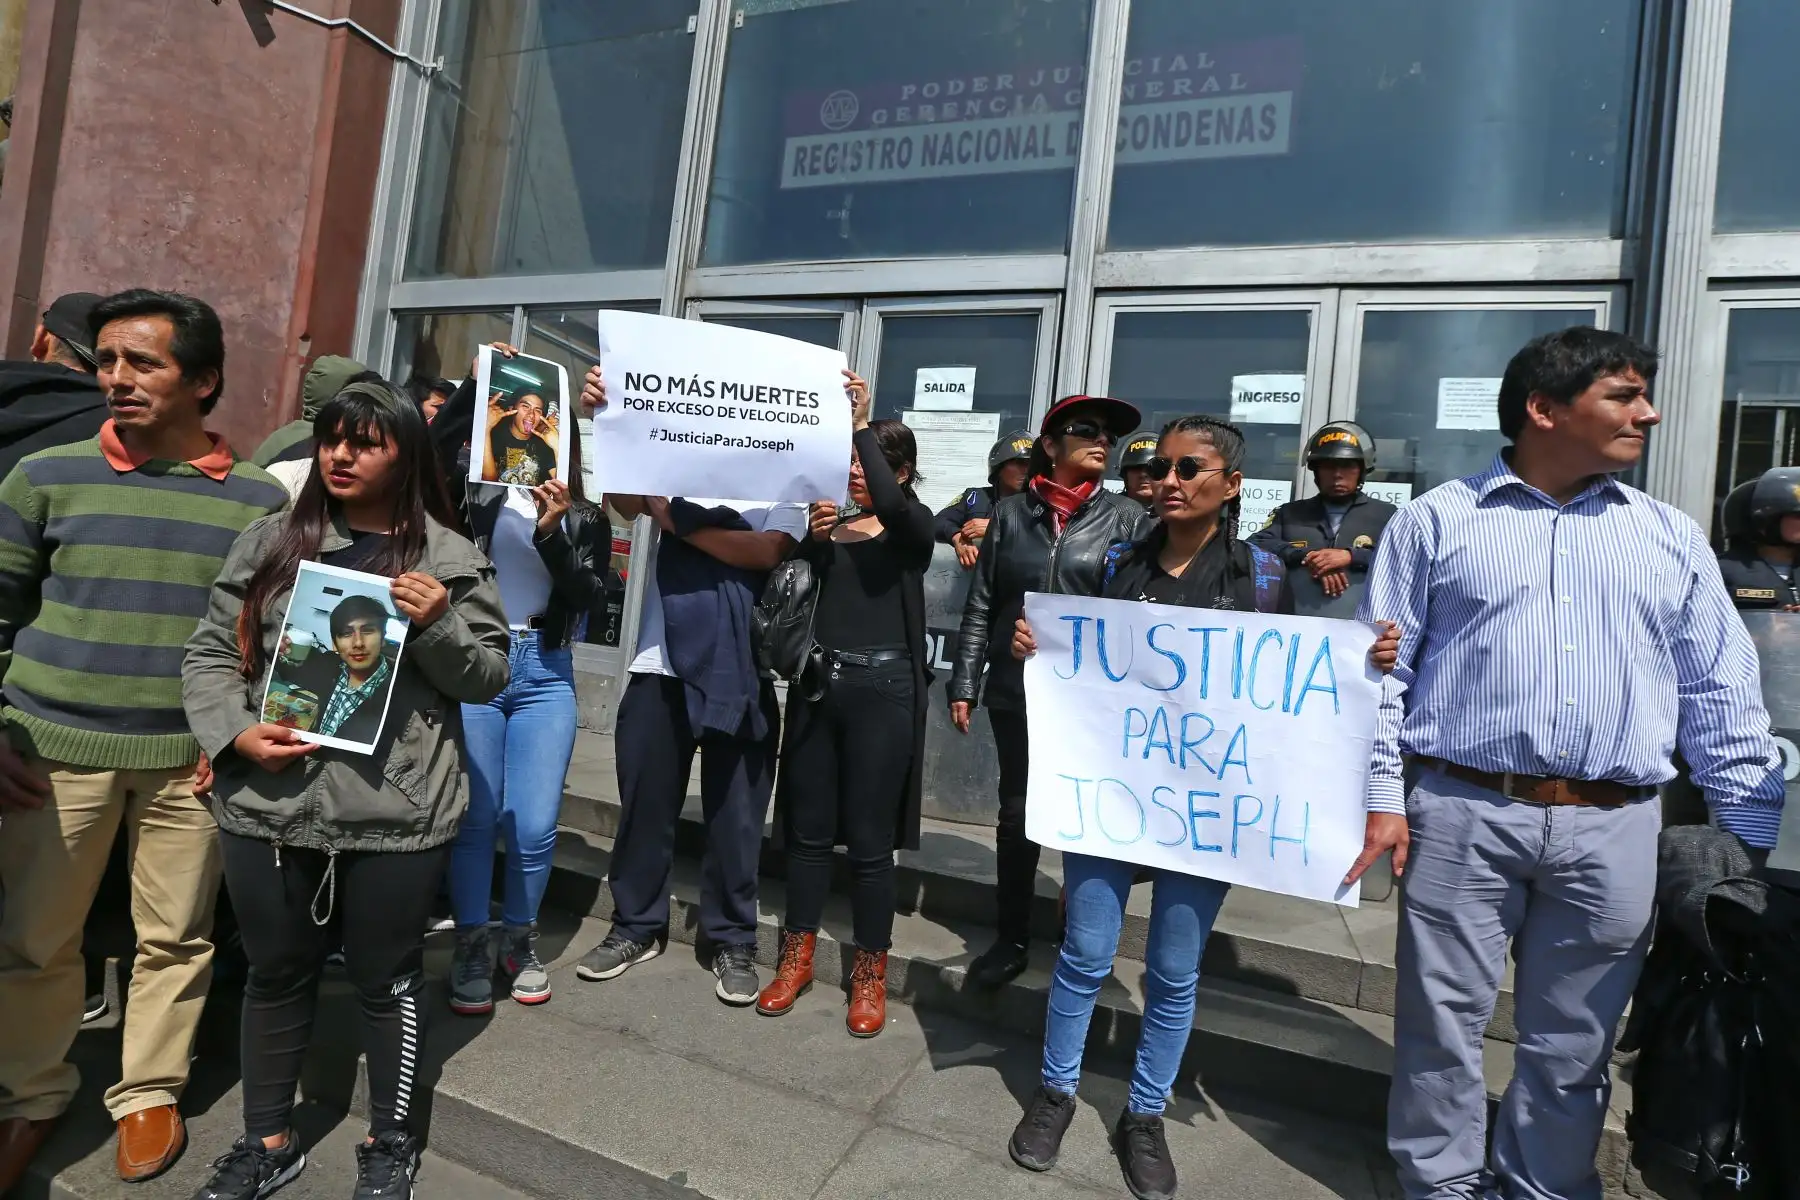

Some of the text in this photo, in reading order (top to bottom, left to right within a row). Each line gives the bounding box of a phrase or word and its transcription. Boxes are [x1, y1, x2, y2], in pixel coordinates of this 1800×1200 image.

[901, 52, 1216, 101] PODER JUCIAL
[1064, 73, 1247, 106] GNERAL
[792, 136, 914, 178] REGISTRO
[920, 122, 1057, 168] NACIONAL
[1115, 102, 1277, 153] CONDENAS
[624, 371, 820, 409] NO MÁS MUERTES
[923, 382, 966, 394] SALIDA
[1237, 390, 1301, 404] INGRESO
[623, 397, 820, 426] POR EXCESO DE VELOCIDAD
[649, 427, 795, 453] #JusticiaParaJoseph
[1241, 487, 1283, 501] NO SE
[1365, 491, 1403, 504] O SE
[1243, 507, 1273, 515] NECESIT
[1240, 520, 1265, 533] FOT
[1053, 615, 1341, 716] JUSTICIA
[1122, 705, 1253, 784] PARA
[1056, 773, 1310, 866] JOSEPH
